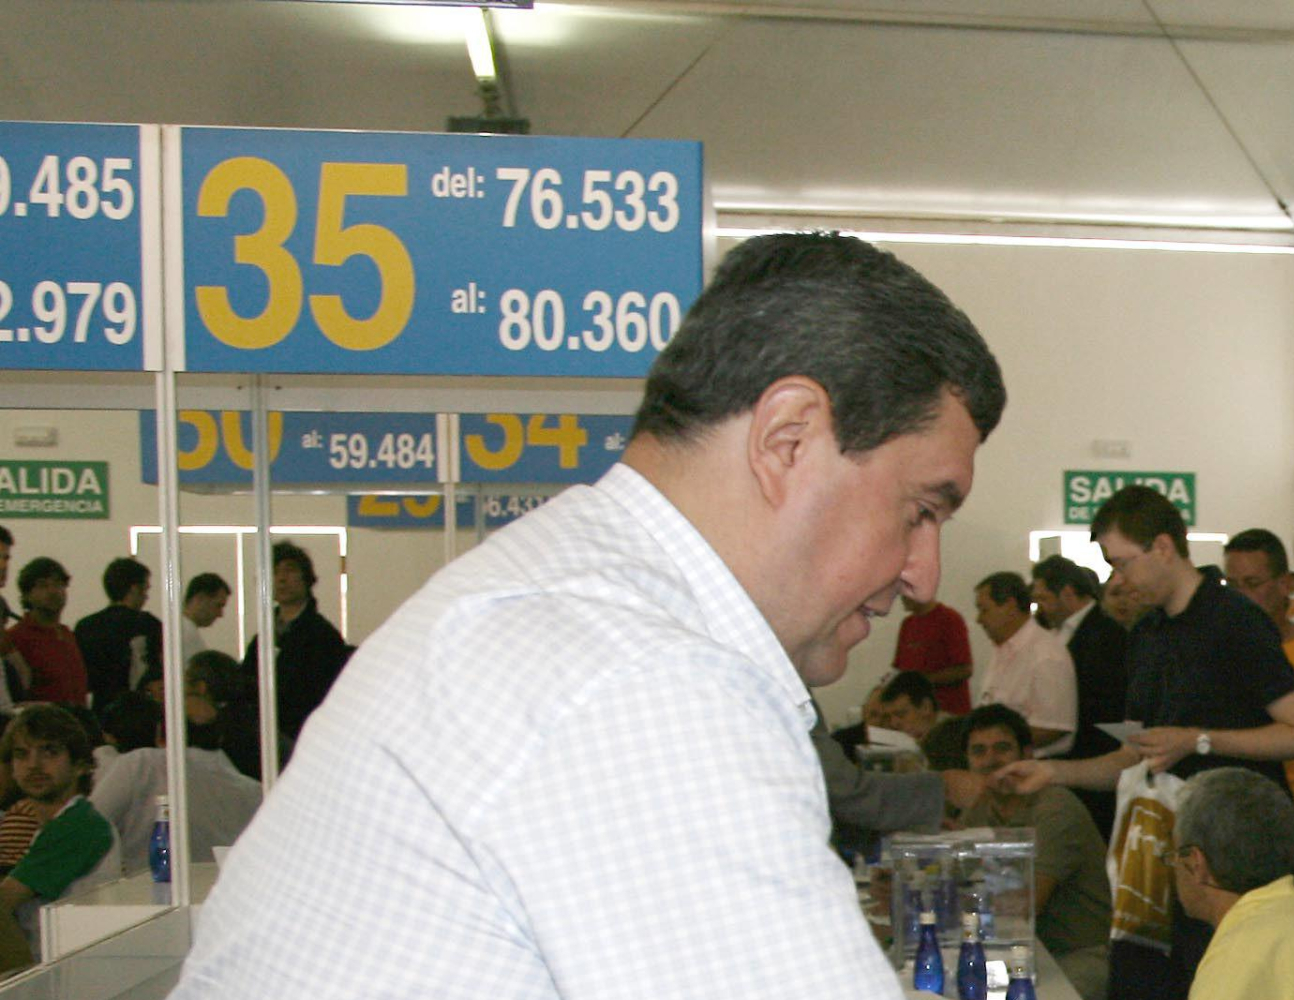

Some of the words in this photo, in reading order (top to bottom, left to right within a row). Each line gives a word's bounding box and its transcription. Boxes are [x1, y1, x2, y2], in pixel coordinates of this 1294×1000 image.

[430, 165, 486, 199] del:
[495, 167, 680, 233] 76.533
[195, 156, 416, 350] 35
[450, 281, 487, 315] al:
[498, 288, 683, 353] 80.360
[329, 432, 435, 469] 59.484
[1069, 475, 1190, 504] SADA
